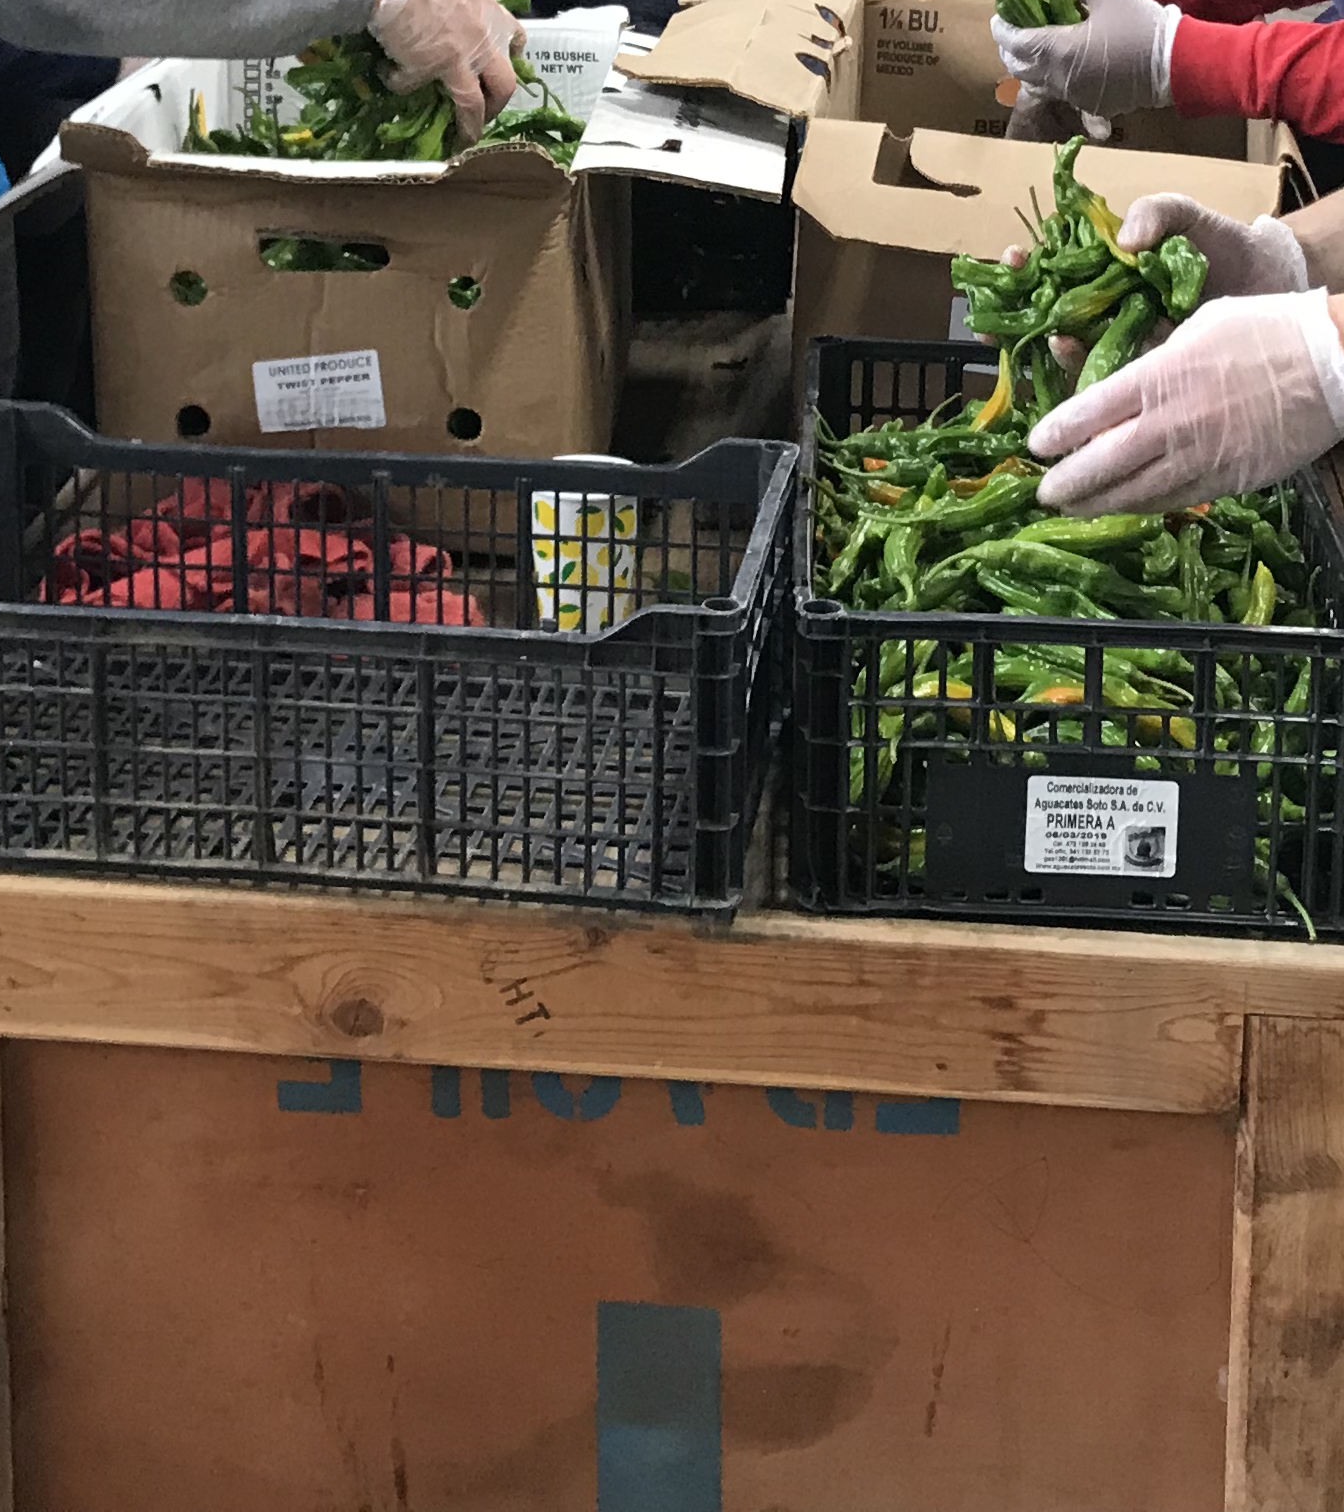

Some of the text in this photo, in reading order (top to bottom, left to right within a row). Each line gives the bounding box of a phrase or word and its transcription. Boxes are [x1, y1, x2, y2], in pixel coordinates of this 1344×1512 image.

[908, 9, 945, 33] BU.
[893, 40, 934, 54] VOLUME
[553, 51, 600, 63] BUSHEL
[877, 51, 925, 66] PRODUCE
[541, 64, 584, 75] NET WT
[876, 63, 914, 76] MEXICO
[268, 355, 372, 377] UNITED PRODUCE
[277, 372, 371, 390] TWIST PEPPER
[1046, 781, 1138, 796] Comercializadora de
[1034, 798, 1166, 814] Aguacates Soto S.A. de C.V.
[1046, 813, 1116, 830] PRIMERA A
